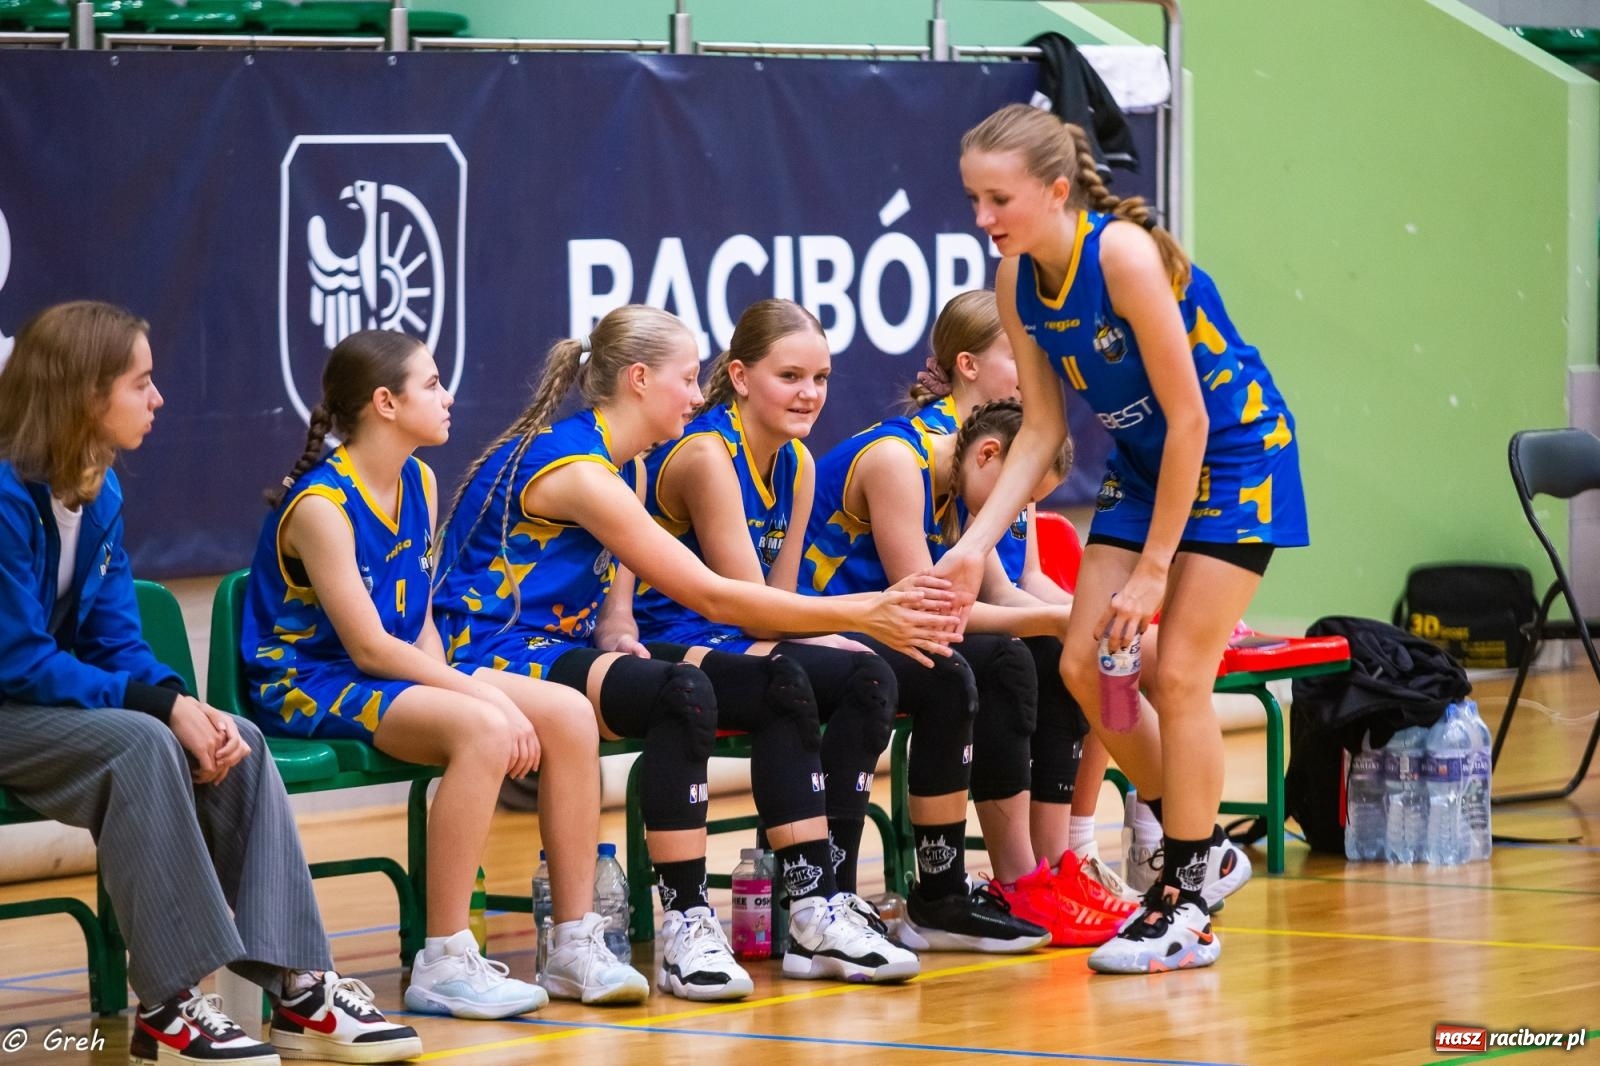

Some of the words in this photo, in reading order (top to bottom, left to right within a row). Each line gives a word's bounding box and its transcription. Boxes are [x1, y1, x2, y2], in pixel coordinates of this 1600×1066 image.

[567, 188, 1001, 362] RACIBÓR
[1045, 319, 1081, 332] regio
[1061, 355, 1088, 390] 11
[396, 578, 407, 618] 4
